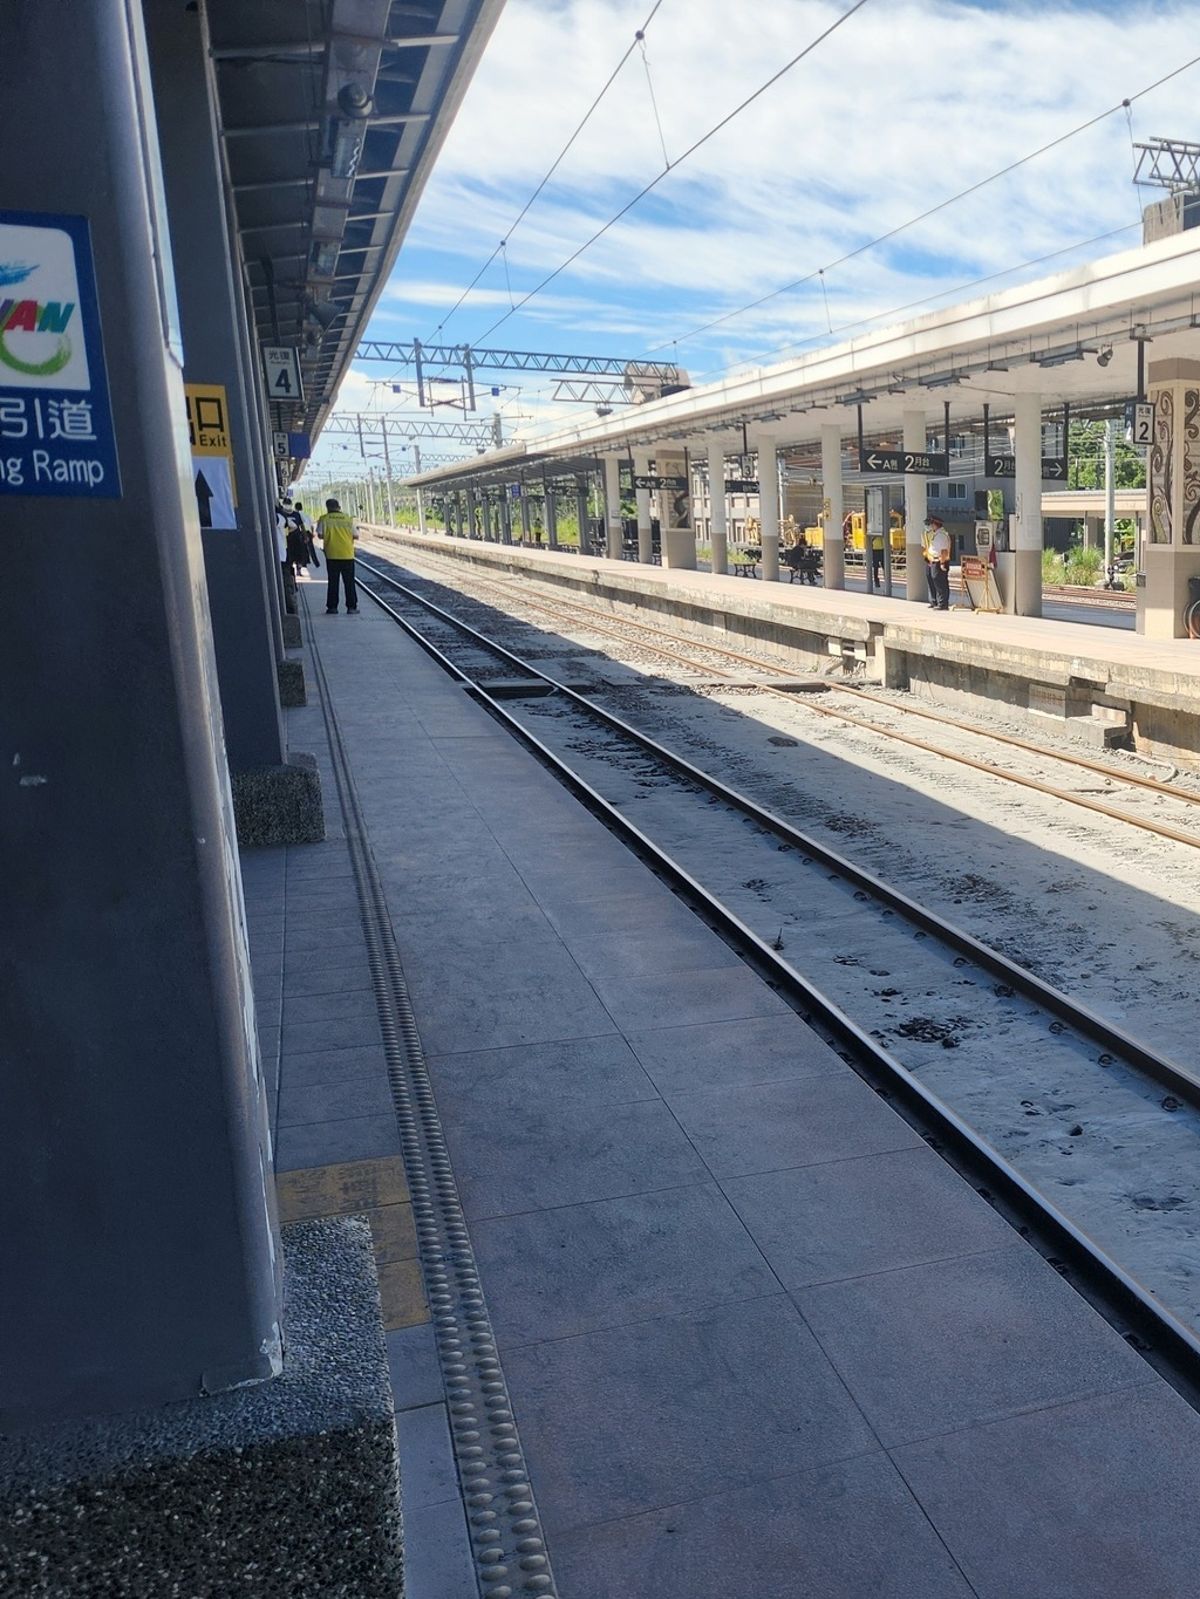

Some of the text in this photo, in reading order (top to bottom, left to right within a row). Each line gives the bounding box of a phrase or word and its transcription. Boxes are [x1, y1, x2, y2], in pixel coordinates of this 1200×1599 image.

[275, 369, 291, 393] 4
[1139, 421, 1149, 440] 2
[200, 434, 227, 447] Exit
[278, 442, 286, 455] 5
[33, 449, 104, 487] Ramp
[745, 465, 751, 476] 3
